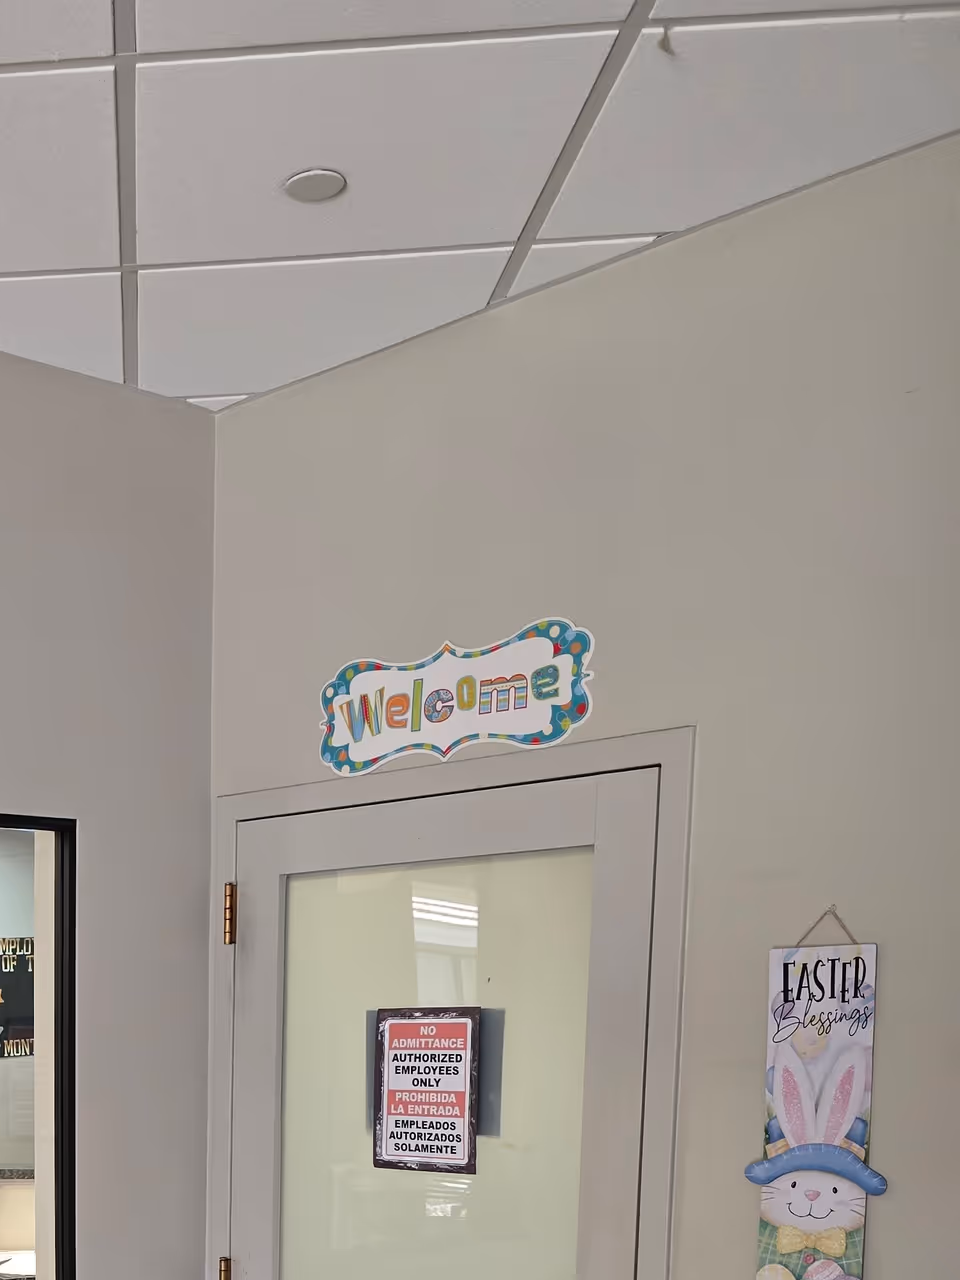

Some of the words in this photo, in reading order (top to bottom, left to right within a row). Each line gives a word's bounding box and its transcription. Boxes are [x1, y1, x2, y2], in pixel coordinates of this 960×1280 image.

[339, 664, 560, 743] Welcome
[1, 955, 17, 972] OF
[781, 956, 867, 1004] EASTER
[772, 996, 873, 1043] Blessings
[420, 1026, 437, 1035] NO
[391, 1038, 465, 1048] ADMITTANCE
[392, 1053, 463, 1063] AUTHORIZED
[394, 1065, 459, 1075] EMPLOYEES
[412, 1078, 441, 1087] ONLY
[395, 1092, 457, 1104] PROHIBIDA
[391, 1104, 405, 1114] LA
[408, 1105, 460, 1116] ENTRADA
[394, 1120, 457, 1131] EMPLEADOS
[389, 1131, 462, 1143] AUTORIZADOS
[393, 1143, 457, 1154] SOLAMENTE
